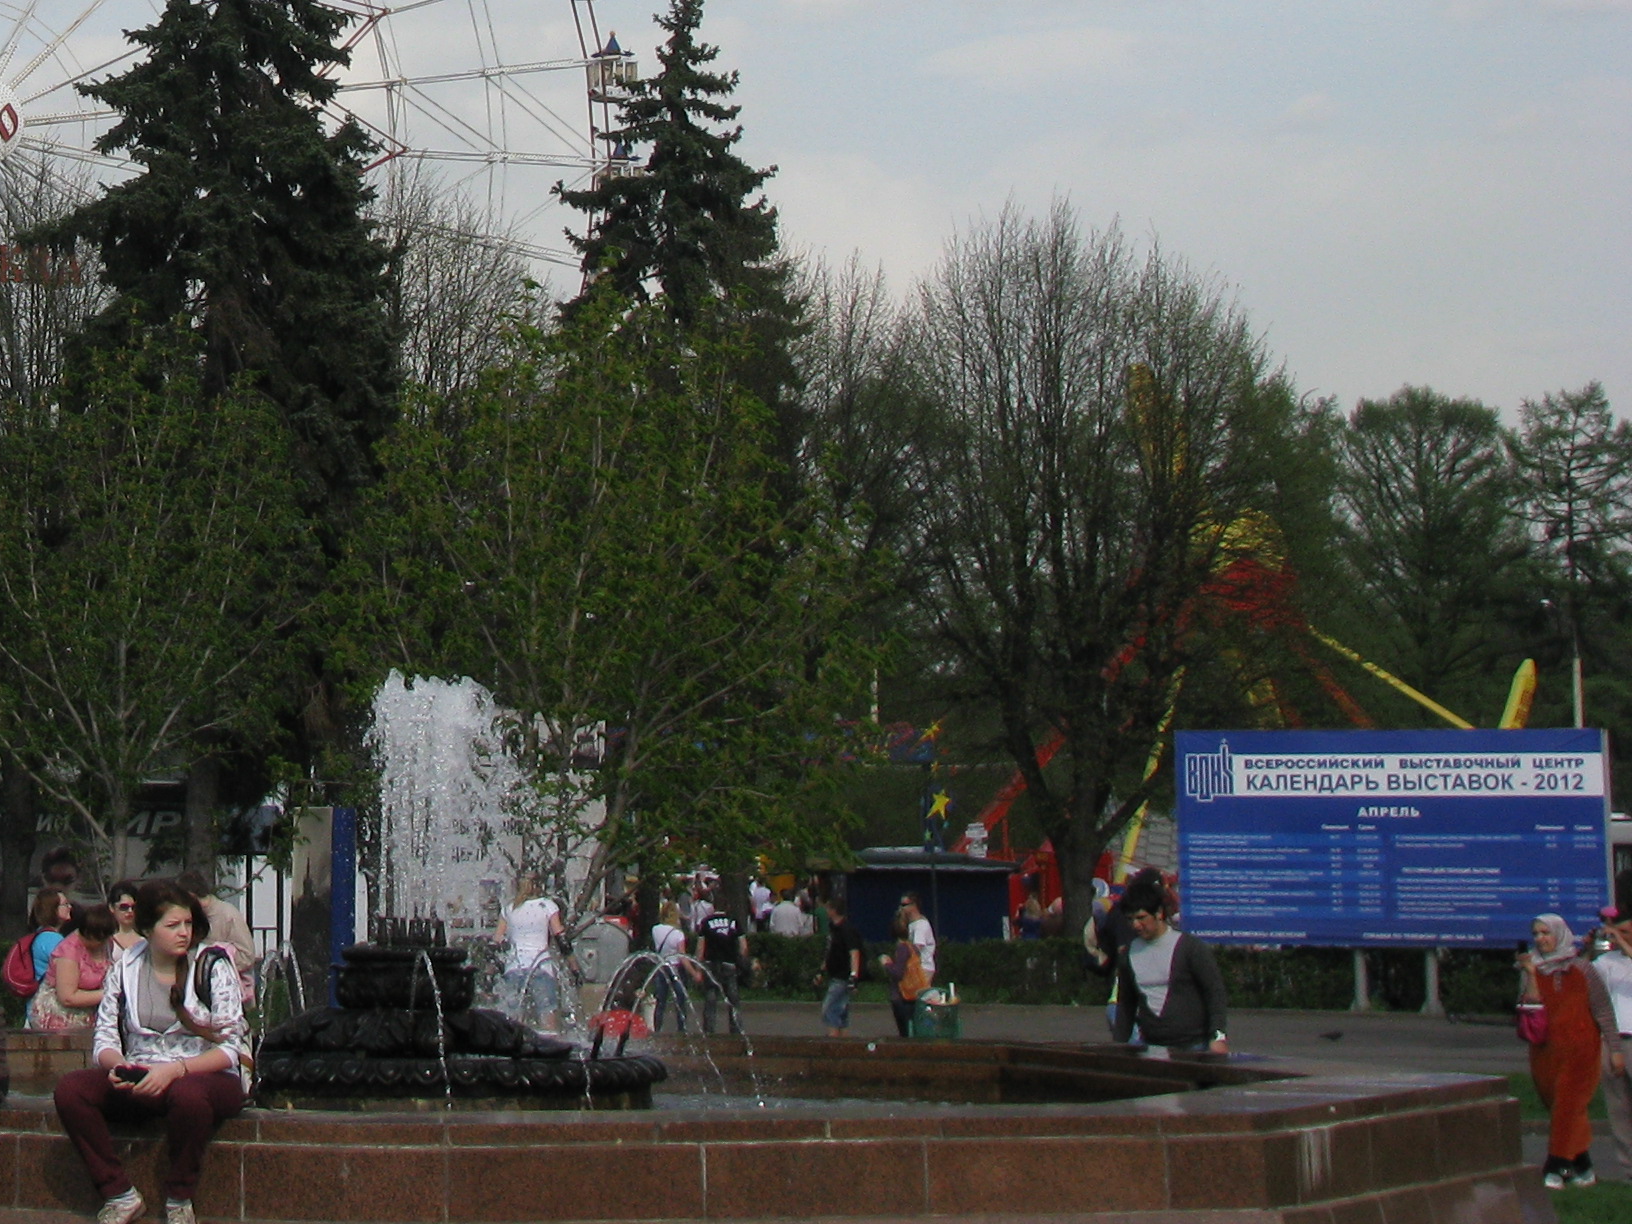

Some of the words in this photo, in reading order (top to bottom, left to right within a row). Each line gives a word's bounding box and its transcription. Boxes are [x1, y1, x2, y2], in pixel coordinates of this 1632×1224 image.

[1244, 756, 1385, 769] ВСЕРОССИЙСКИЙ
[1399, 755, 1521, 769] ВЫСТАВОЧНЫЙ
[1532, 757, 1584, 769] ЦЕНТР
[1246, 773, 1379, 792] КАЛЕНДАРЬ
[1387, 773, 1513, 791] ВЫСТАВОК
[1534, 773, 1584, 791] 2012
[1357, 806, 1420, 818] АПРЕЛЬ
